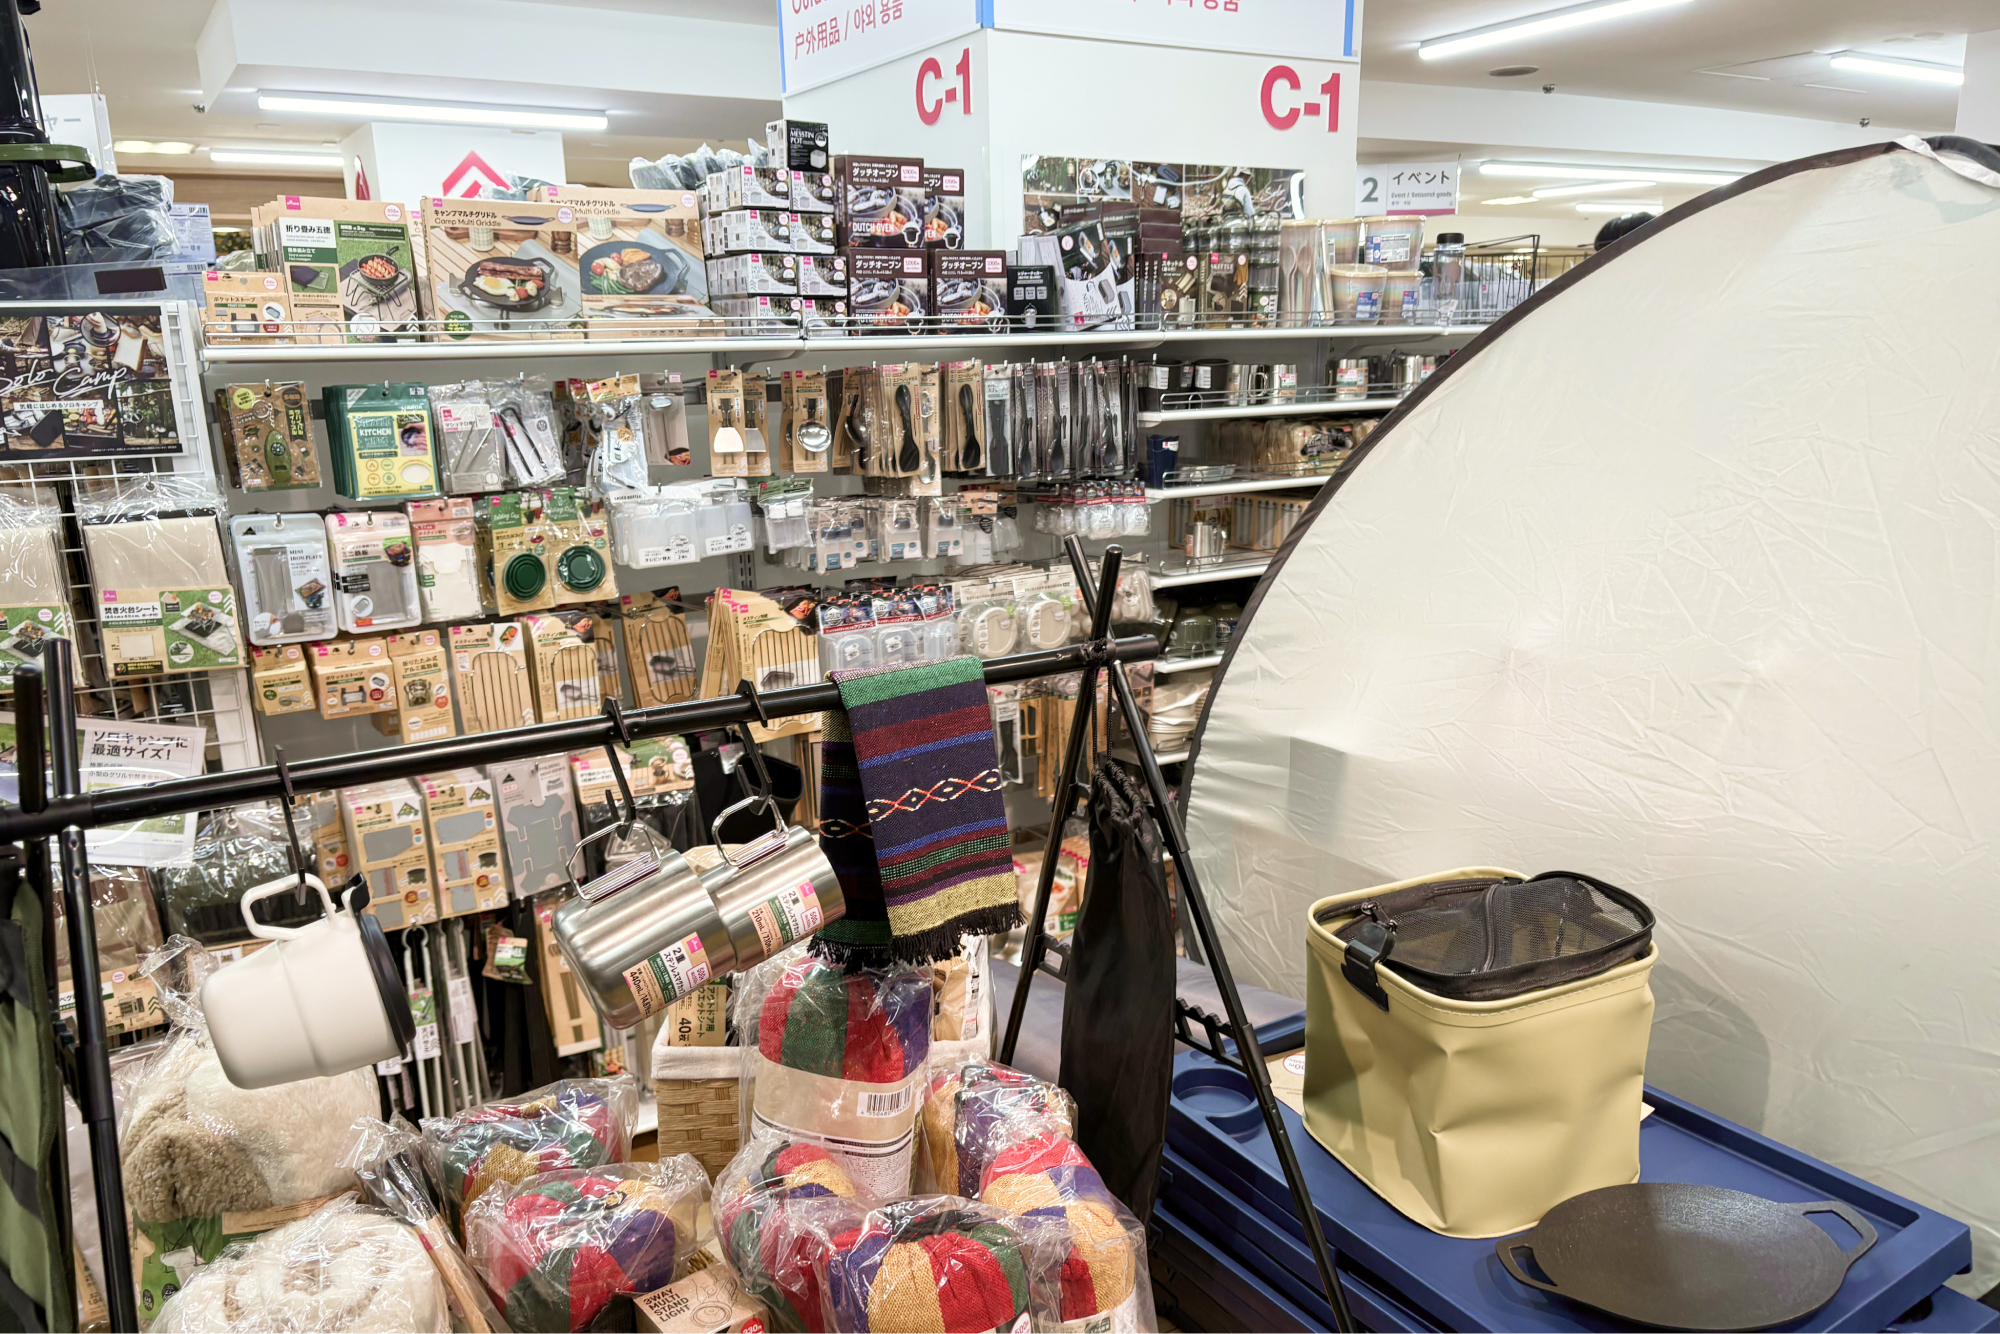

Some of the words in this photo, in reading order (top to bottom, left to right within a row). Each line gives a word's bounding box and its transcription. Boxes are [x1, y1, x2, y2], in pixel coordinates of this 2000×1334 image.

[795, 17, 841, 60] 户外用品
[853, 0, 877, 33] 야외
[915, 47, 974, 126] C-1
[1260, 65, 1342, 133] C-1
[852, 168, 899, 178] ダッチオーブン
[1393, 170, 1450, 186] イベント
[1360, 176, 1379, 204] 2
[434, 209, 497, 219] キャンプマルチグリドル
[596, 207, 620, 216] Griddle
[434, 218, 456, 227] Camp
[457, 218, 475, 227] Multi
[476, 219, 501, 228] Griddle
[852, 221, 875, 233] DUTCH
[876, 222, 894, 233] OVEN
[855, 260, 902, 270] ダッチオーブン
[941, 261, 984, 271] ダッチオーブン
[213, 296, 256, 304] ポケットストーブ
[0, 359, 54, 393] Solo
[53, 366, 128, 400] Camp
[19, 401, 99, 410] 気軽にはじめるソロキャンプ
[359, 428, 392, 437] KITCHEN
[510, 512, 521, 521] Cup
[104, 605, 159, 615] 焚き火台シート
[325, 671, 363, 681] ポケットストーブ
[94, 730, 189, 749] ソロキャンプに
[91, 743, 172, 761] 最適サイズ！
[706, 986, 716, 1032] アウトドア用
[678, 1017, 692, 1042] 40枚
[643, 1287, 674, 1306] 3WAY
[648, 1292, 681, 1311] MULTI
[653, 1297, 690, 1316] STAND
[659, 1304, 691, 1323] LIGHT
